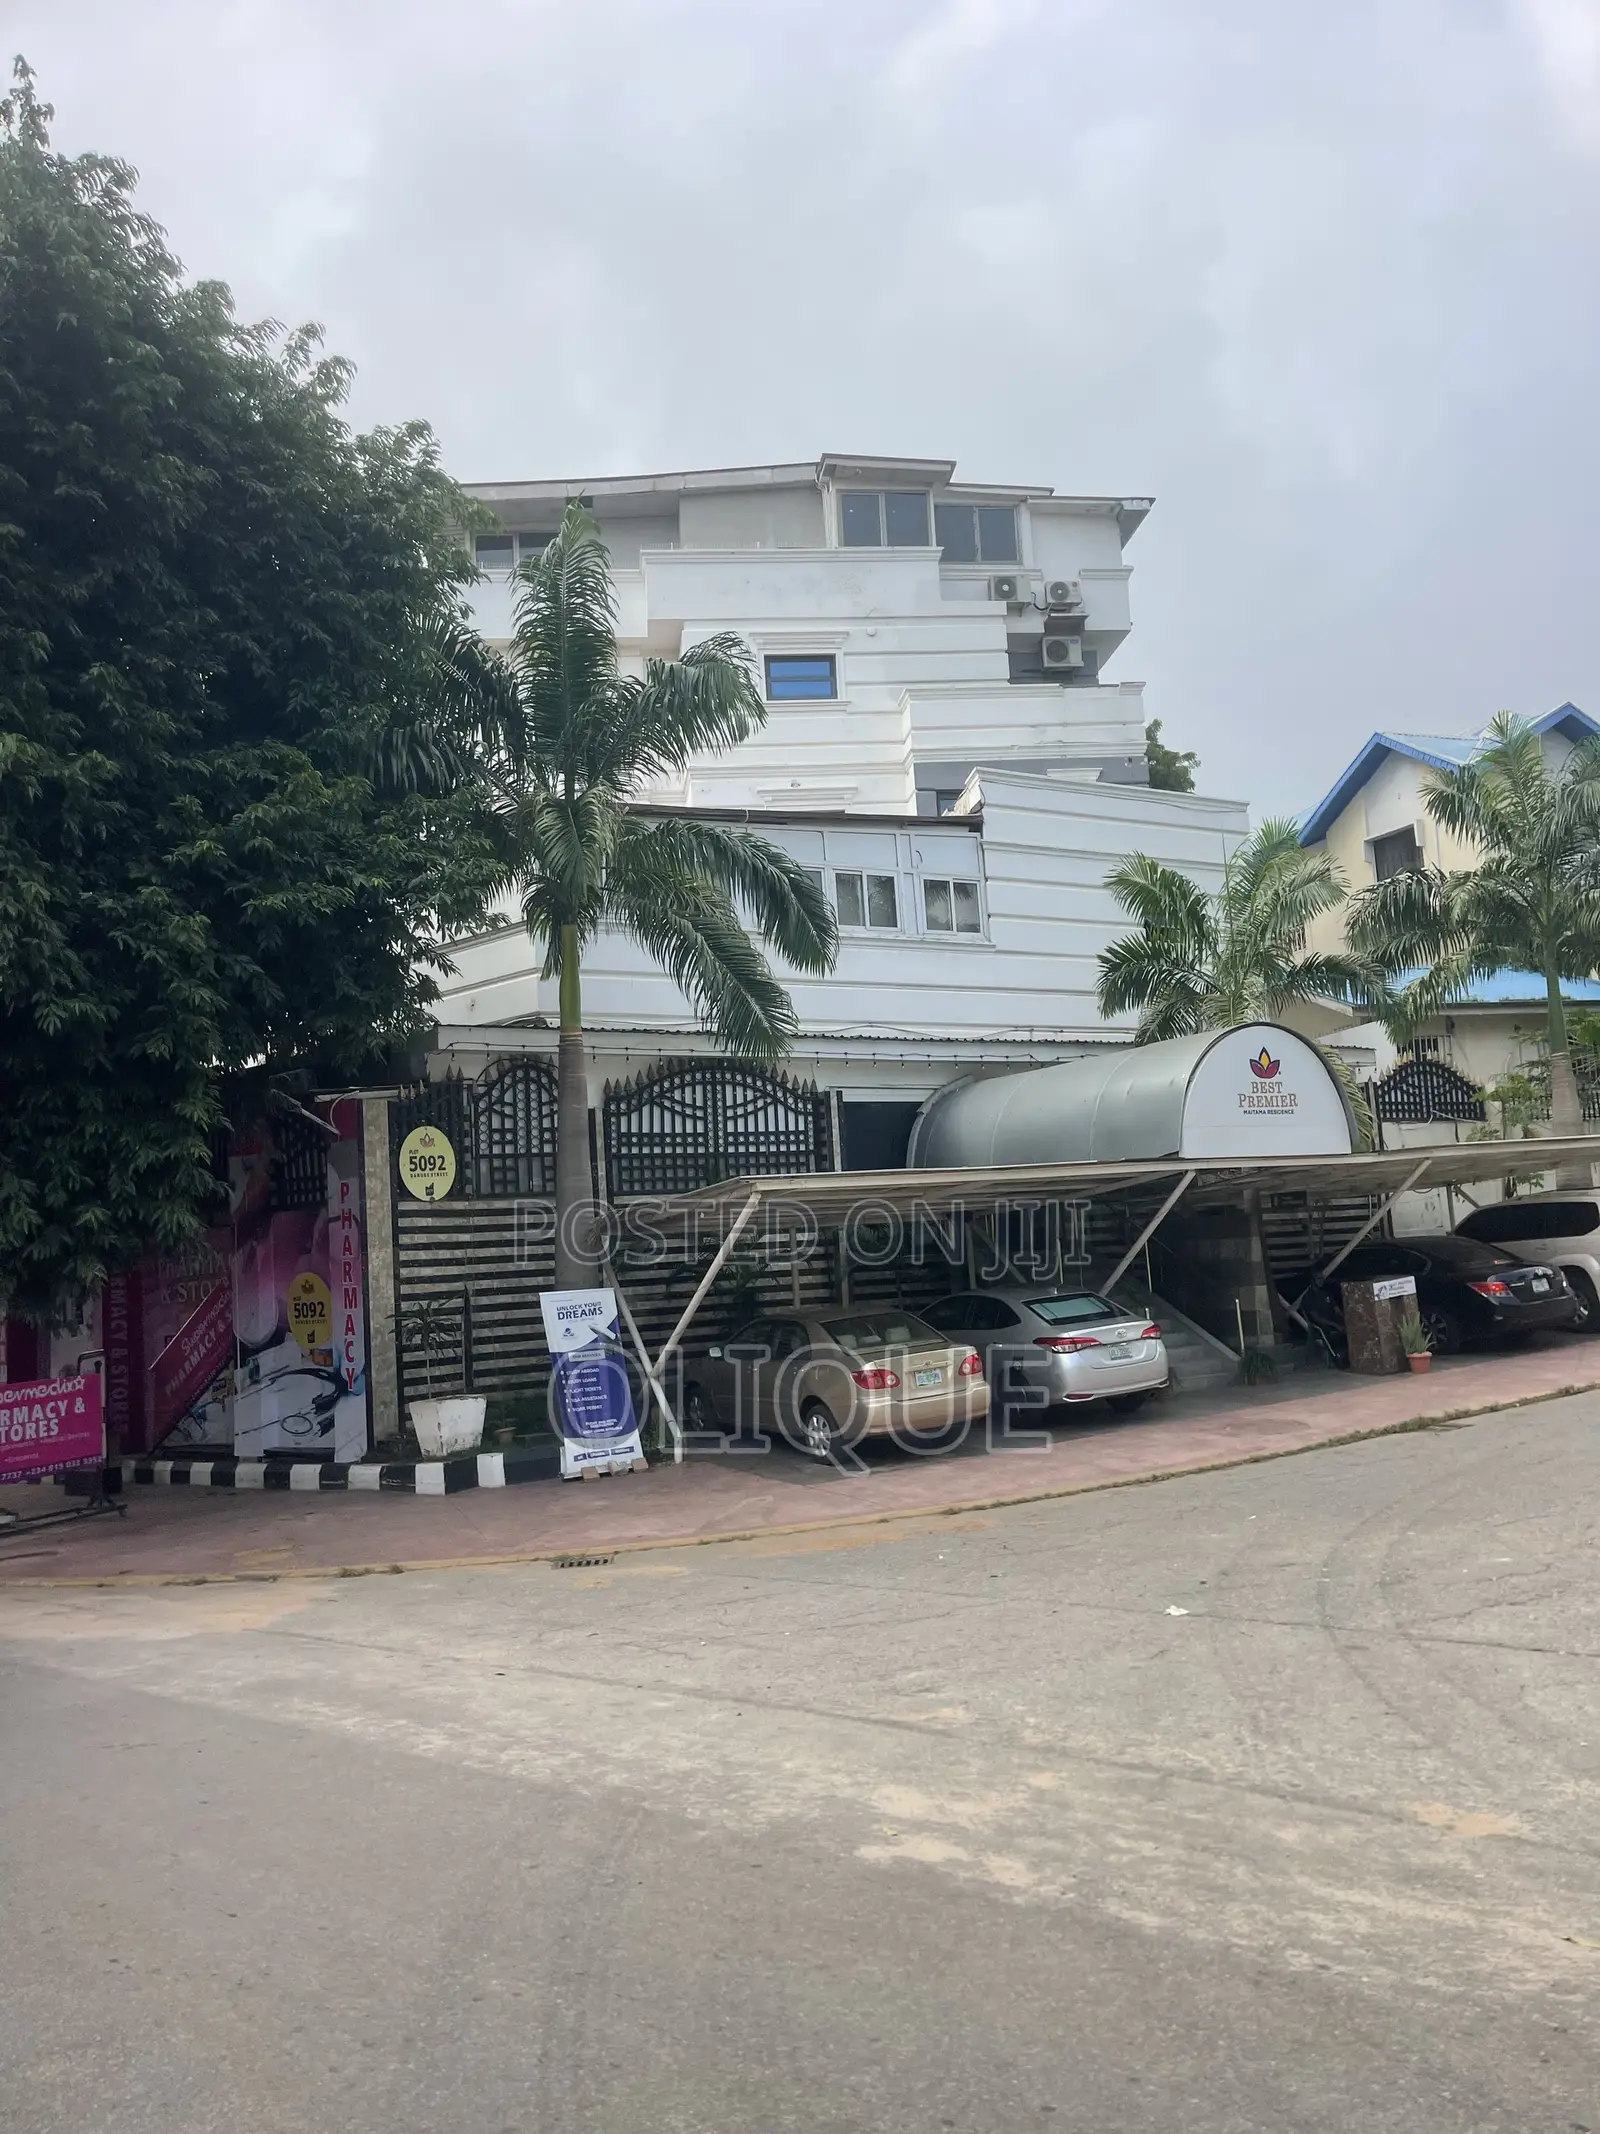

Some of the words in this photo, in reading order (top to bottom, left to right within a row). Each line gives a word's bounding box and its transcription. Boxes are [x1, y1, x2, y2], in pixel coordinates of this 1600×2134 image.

[1251, 1082, 1283, 1093] BEST
[1238, 1093, 1298, 1107] PREMIER
[409, 1155, 447, 1172] 5092
[340, 1182, 358, 1390] PHARMACY
[293, 1301, 326, 1320] 5092
[556, 1304, 583, 1312] UNLOCK
[557, 1306, 603, 1320] DREAMS
[164, 1328, 217, 1397] PHARMACY
[75, 1397, 85, 1414] &
